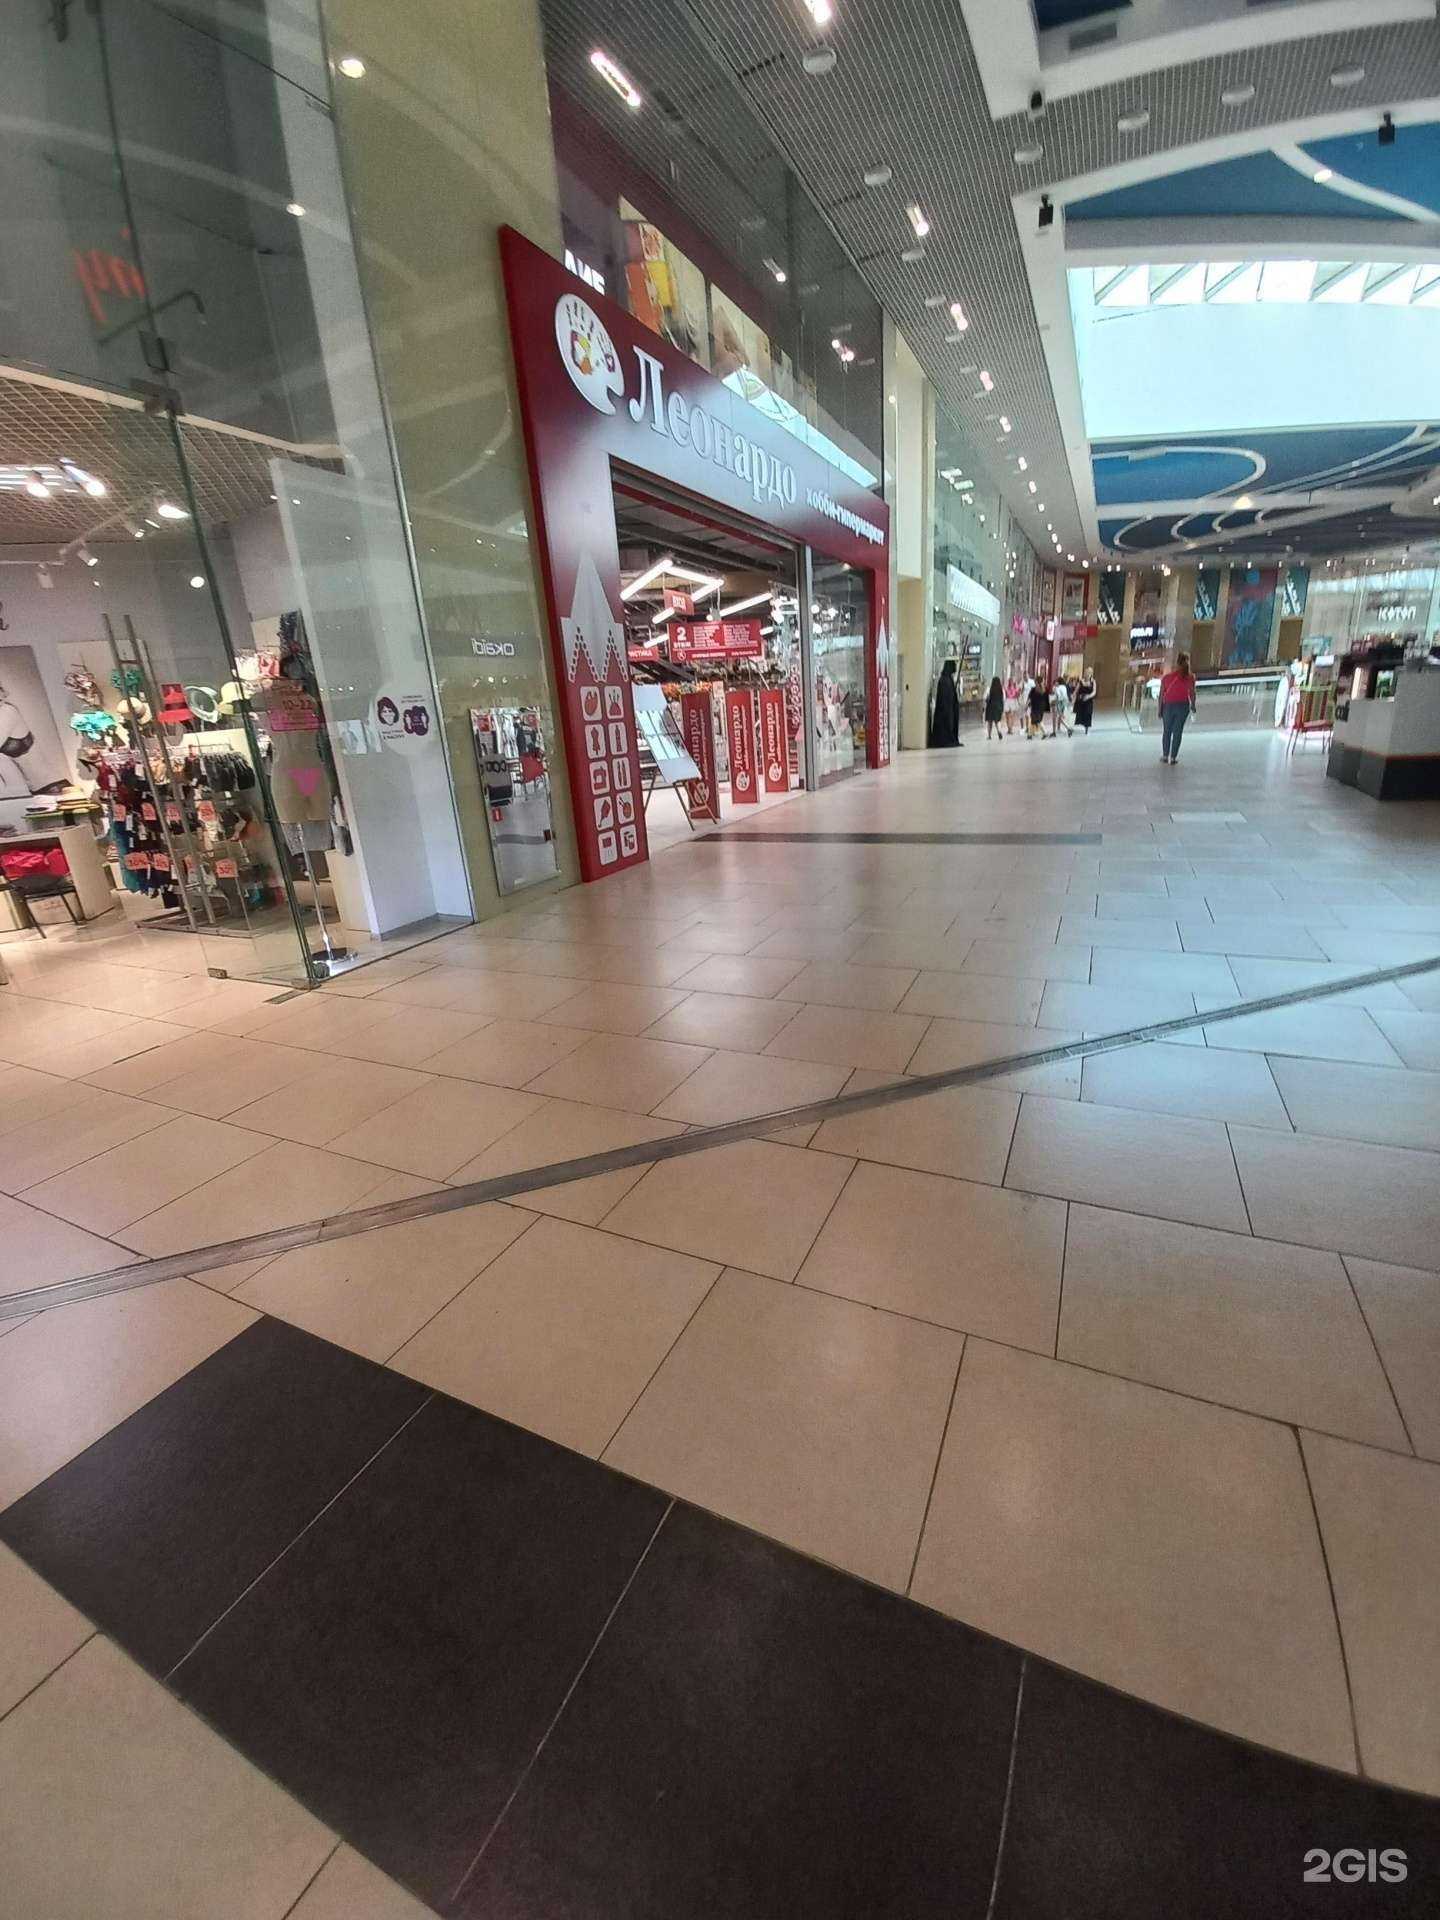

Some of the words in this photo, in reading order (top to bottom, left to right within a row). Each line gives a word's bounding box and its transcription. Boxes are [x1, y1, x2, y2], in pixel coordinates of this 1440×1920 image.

[628, 346, 798, 509] Леонардо
[676, 626, 687, 641] 2
[732, 705, 744, 770] Леонардо
[766, 702, 777, 763] Леонардо
